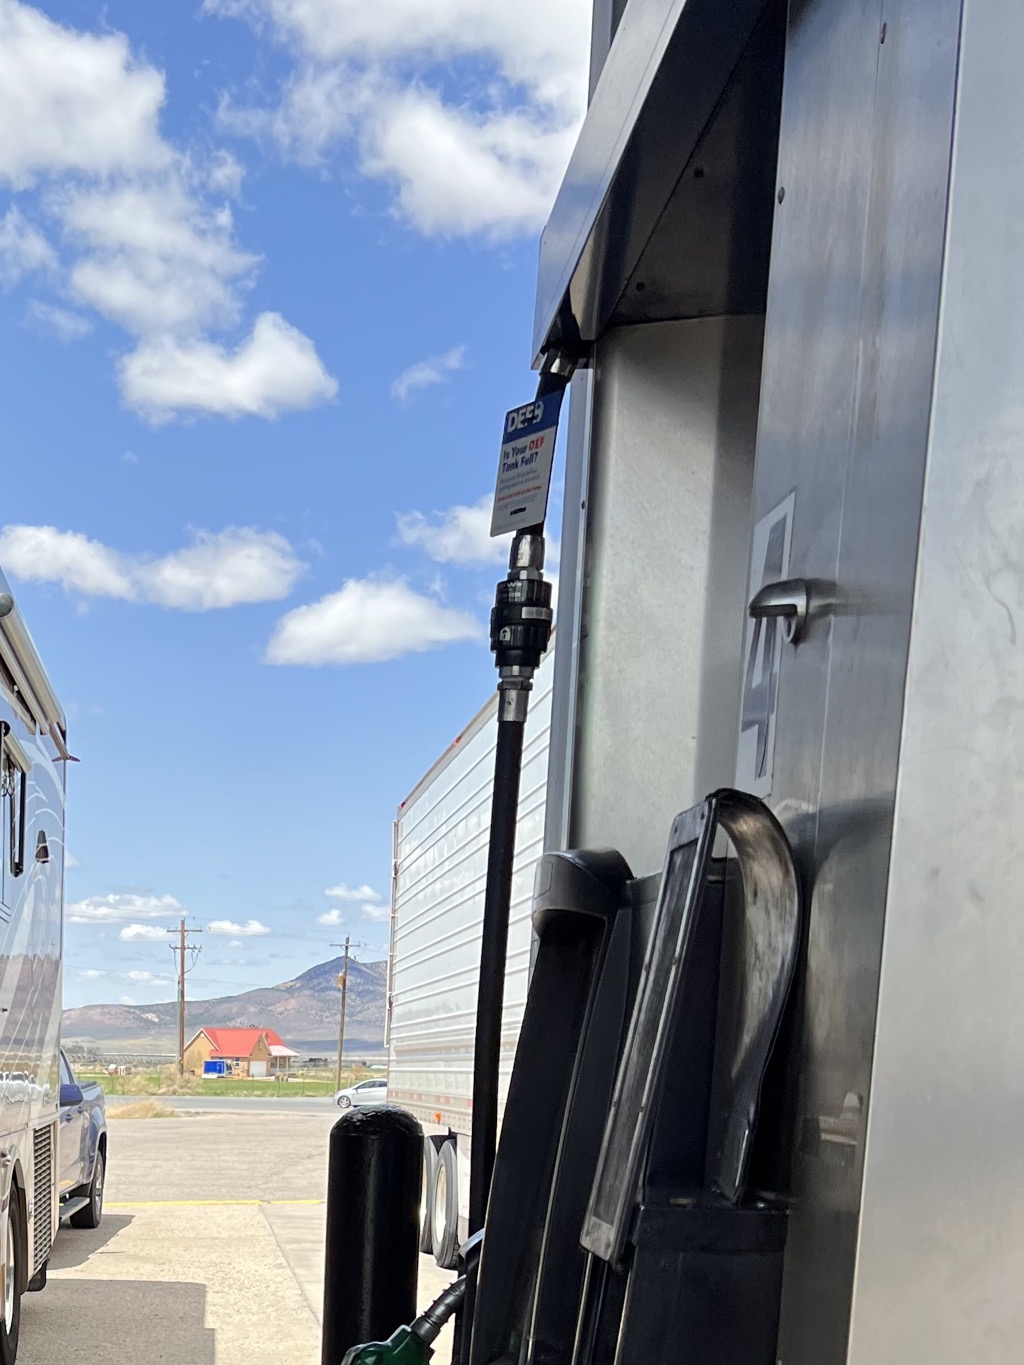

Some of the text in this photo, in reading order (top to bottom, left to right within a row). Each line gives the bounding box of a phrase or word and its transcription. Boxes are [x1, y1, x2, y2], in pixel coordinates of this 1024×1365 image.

[503, 436, 545, 461] Is Your DEF
[502, 451, 539, 473] Tank Full?
